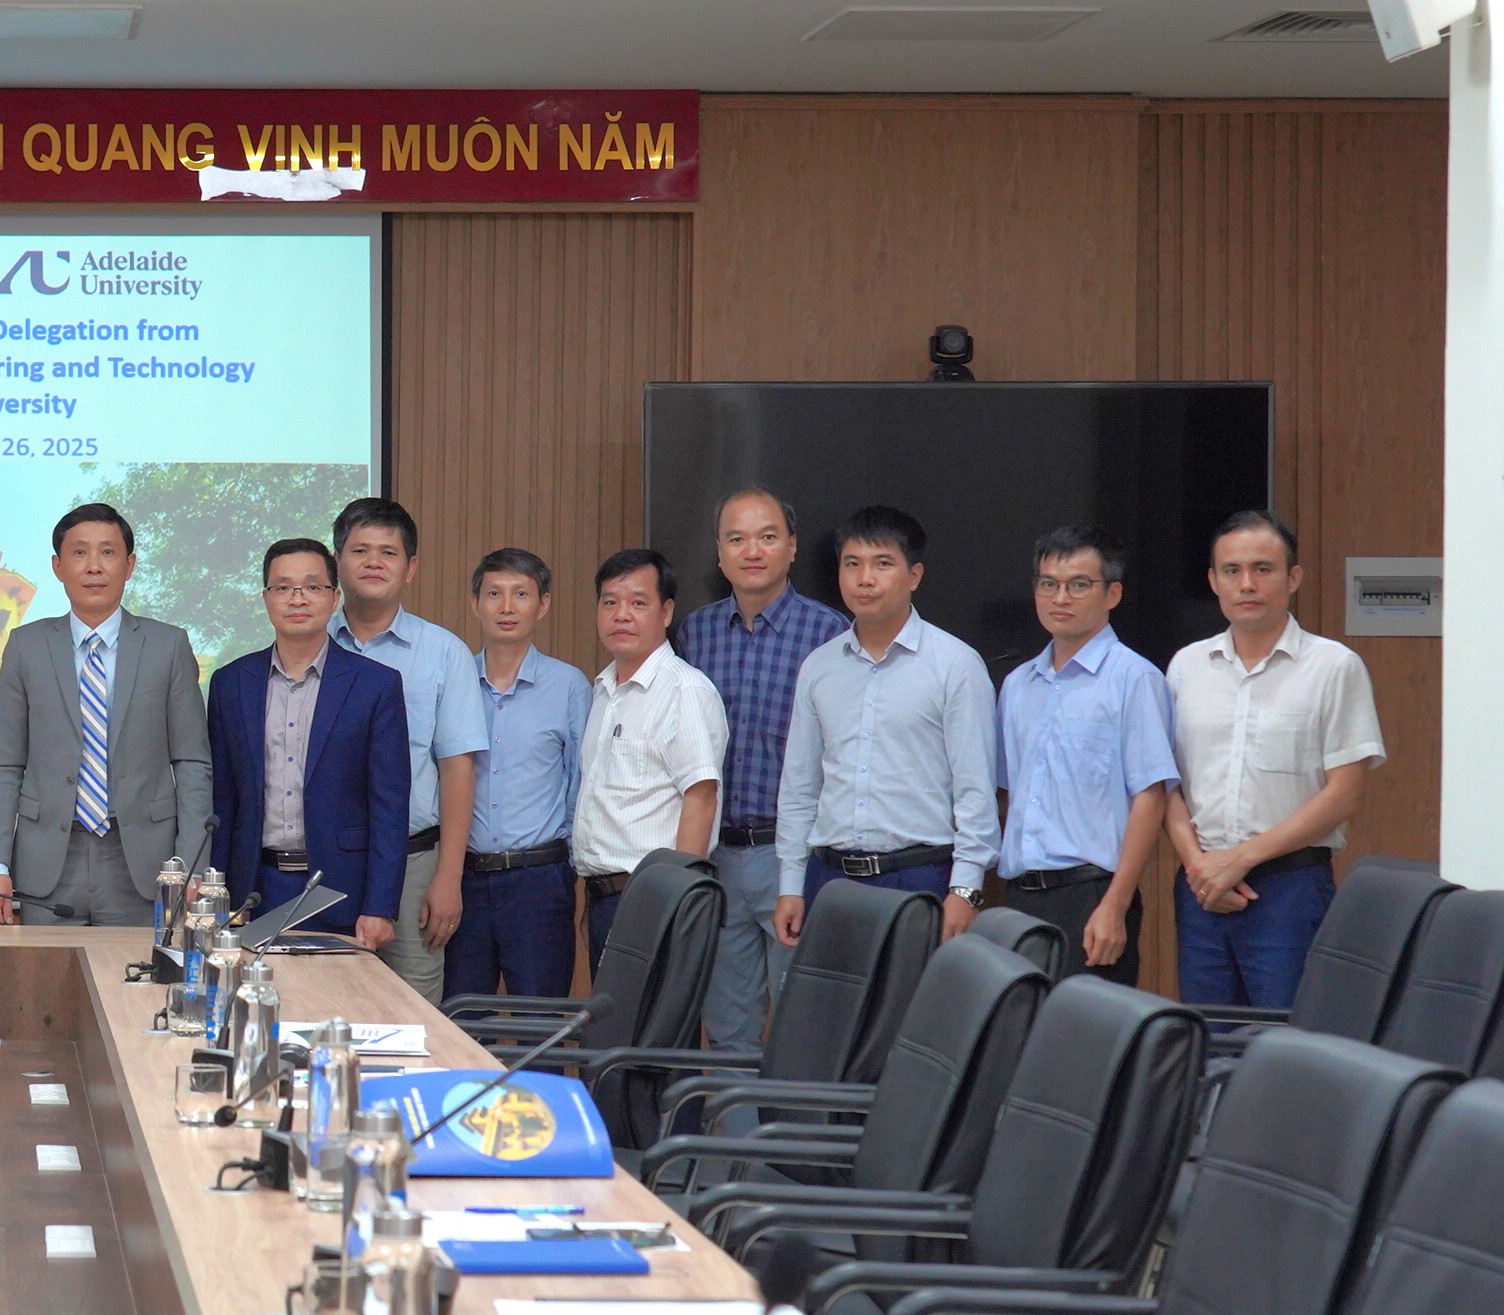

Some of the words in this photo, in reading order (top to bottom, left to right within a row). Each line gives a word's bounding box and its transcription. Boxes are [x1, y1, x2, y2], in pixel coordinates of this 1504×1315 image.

[23, 123, 215, 174] QUANG
[383, 117, 537, 172] MUÔN
[560, 112, 675, 170] NĂM
[80, 250, 188, 272] Adelaide
[80, 274, 203, 301] University
[136, 318, 200, 341] from
[52, 356, 100, 378] and
[107, 355, 256, 384] Technology
[1, 437, 35, 458] 26,
[43, 437, 99, 457] 2025
